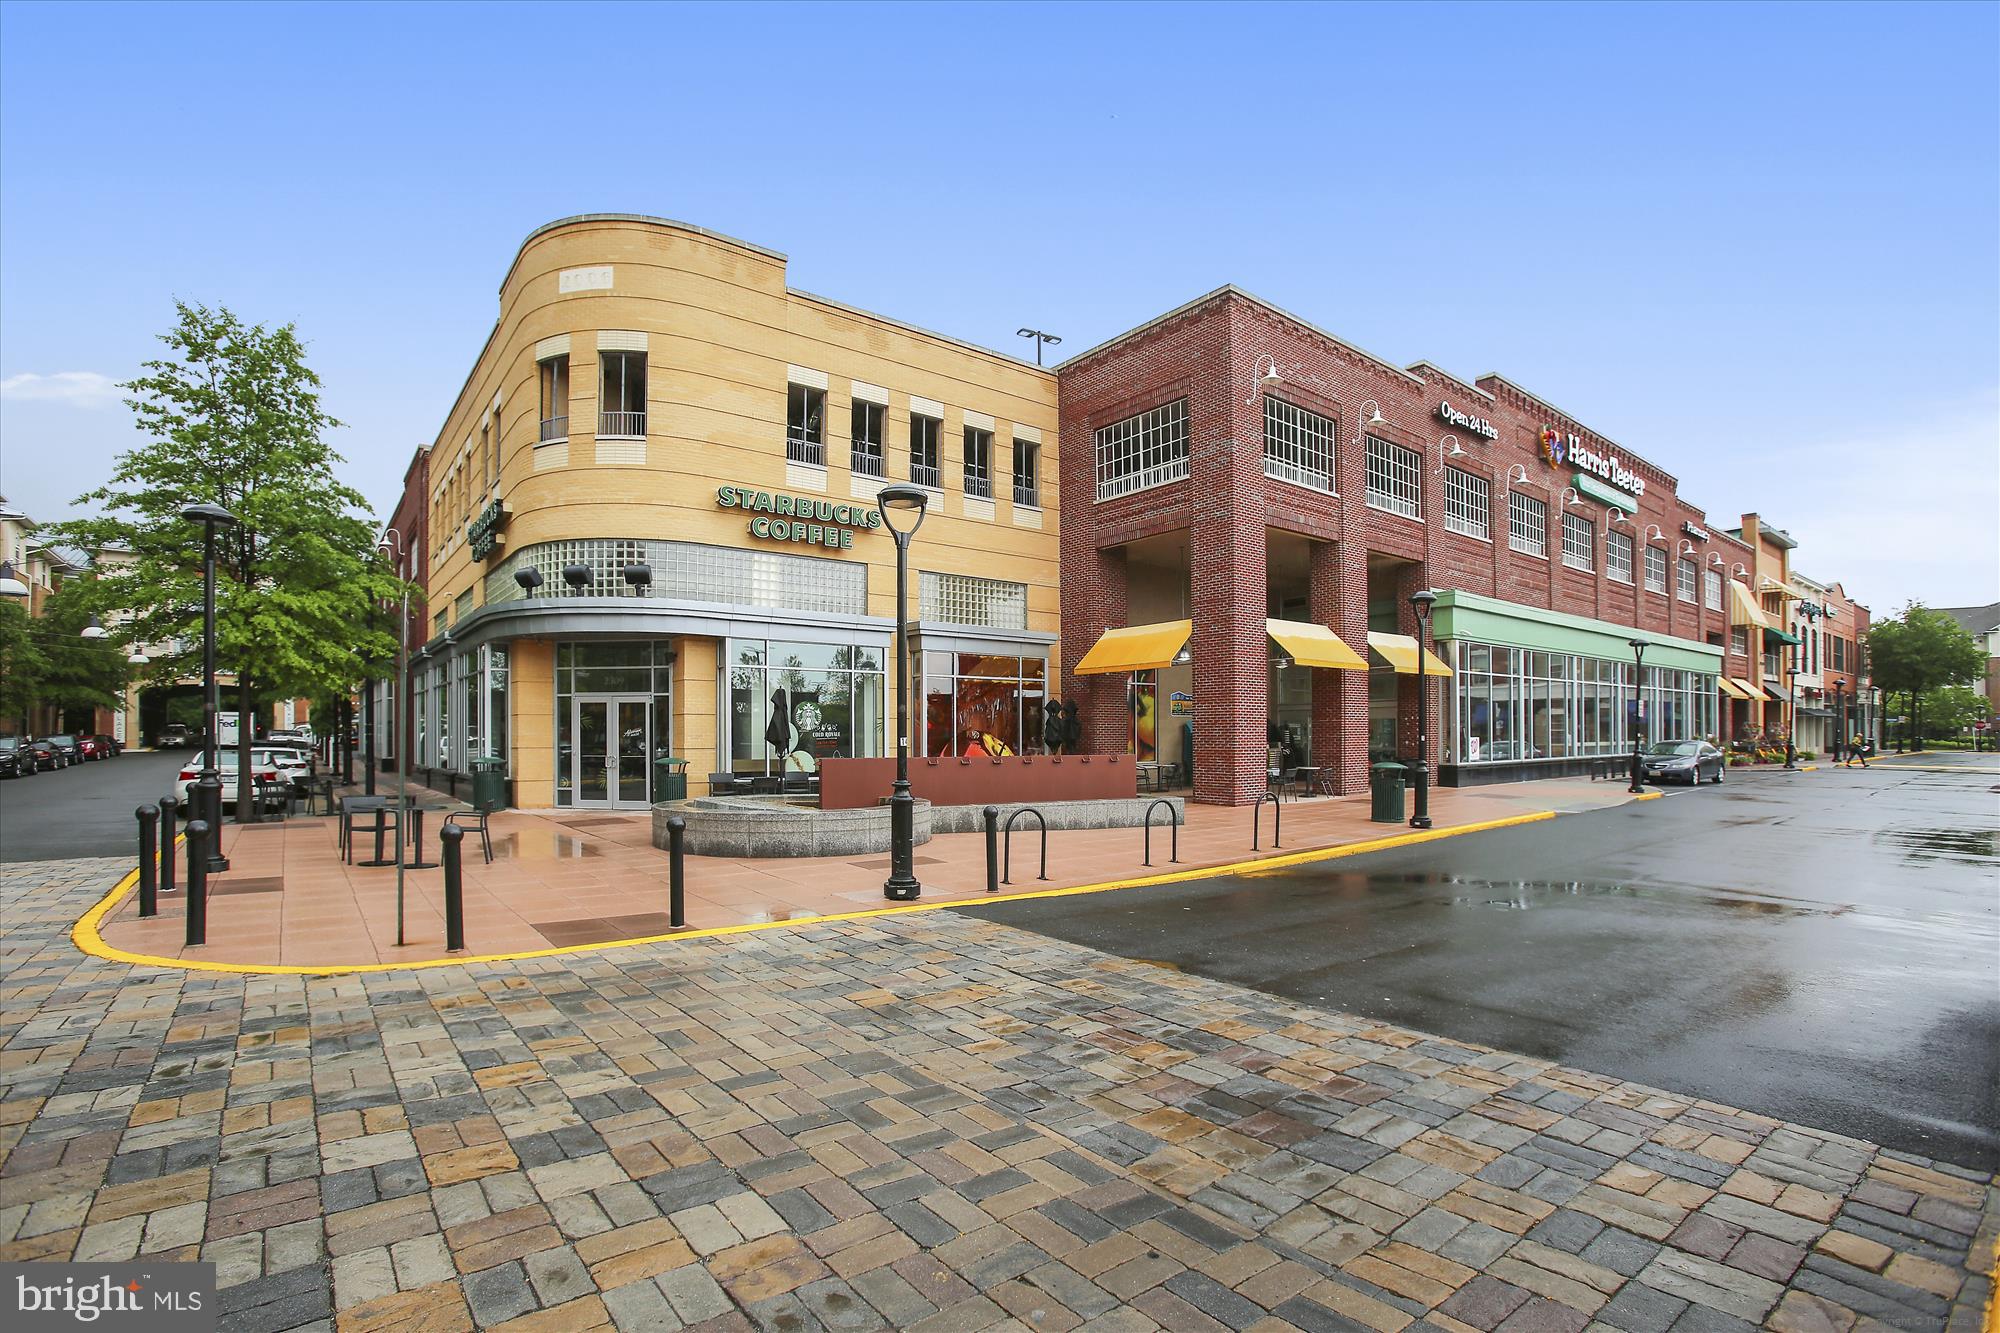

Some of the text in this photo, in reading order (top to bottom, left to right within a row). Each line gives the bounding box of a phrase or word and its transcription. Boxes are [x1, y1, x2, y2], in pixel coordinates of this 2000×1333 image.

[1442, 401, 1499, 440] Open 24 Hrs
[1567, 433, 1609, 479] Harris
[1609, 456, 1646, 496] Teeter
[718, 486, 881, 529] STARBUCKS
[751, 516, 853, 549] COFFEE
